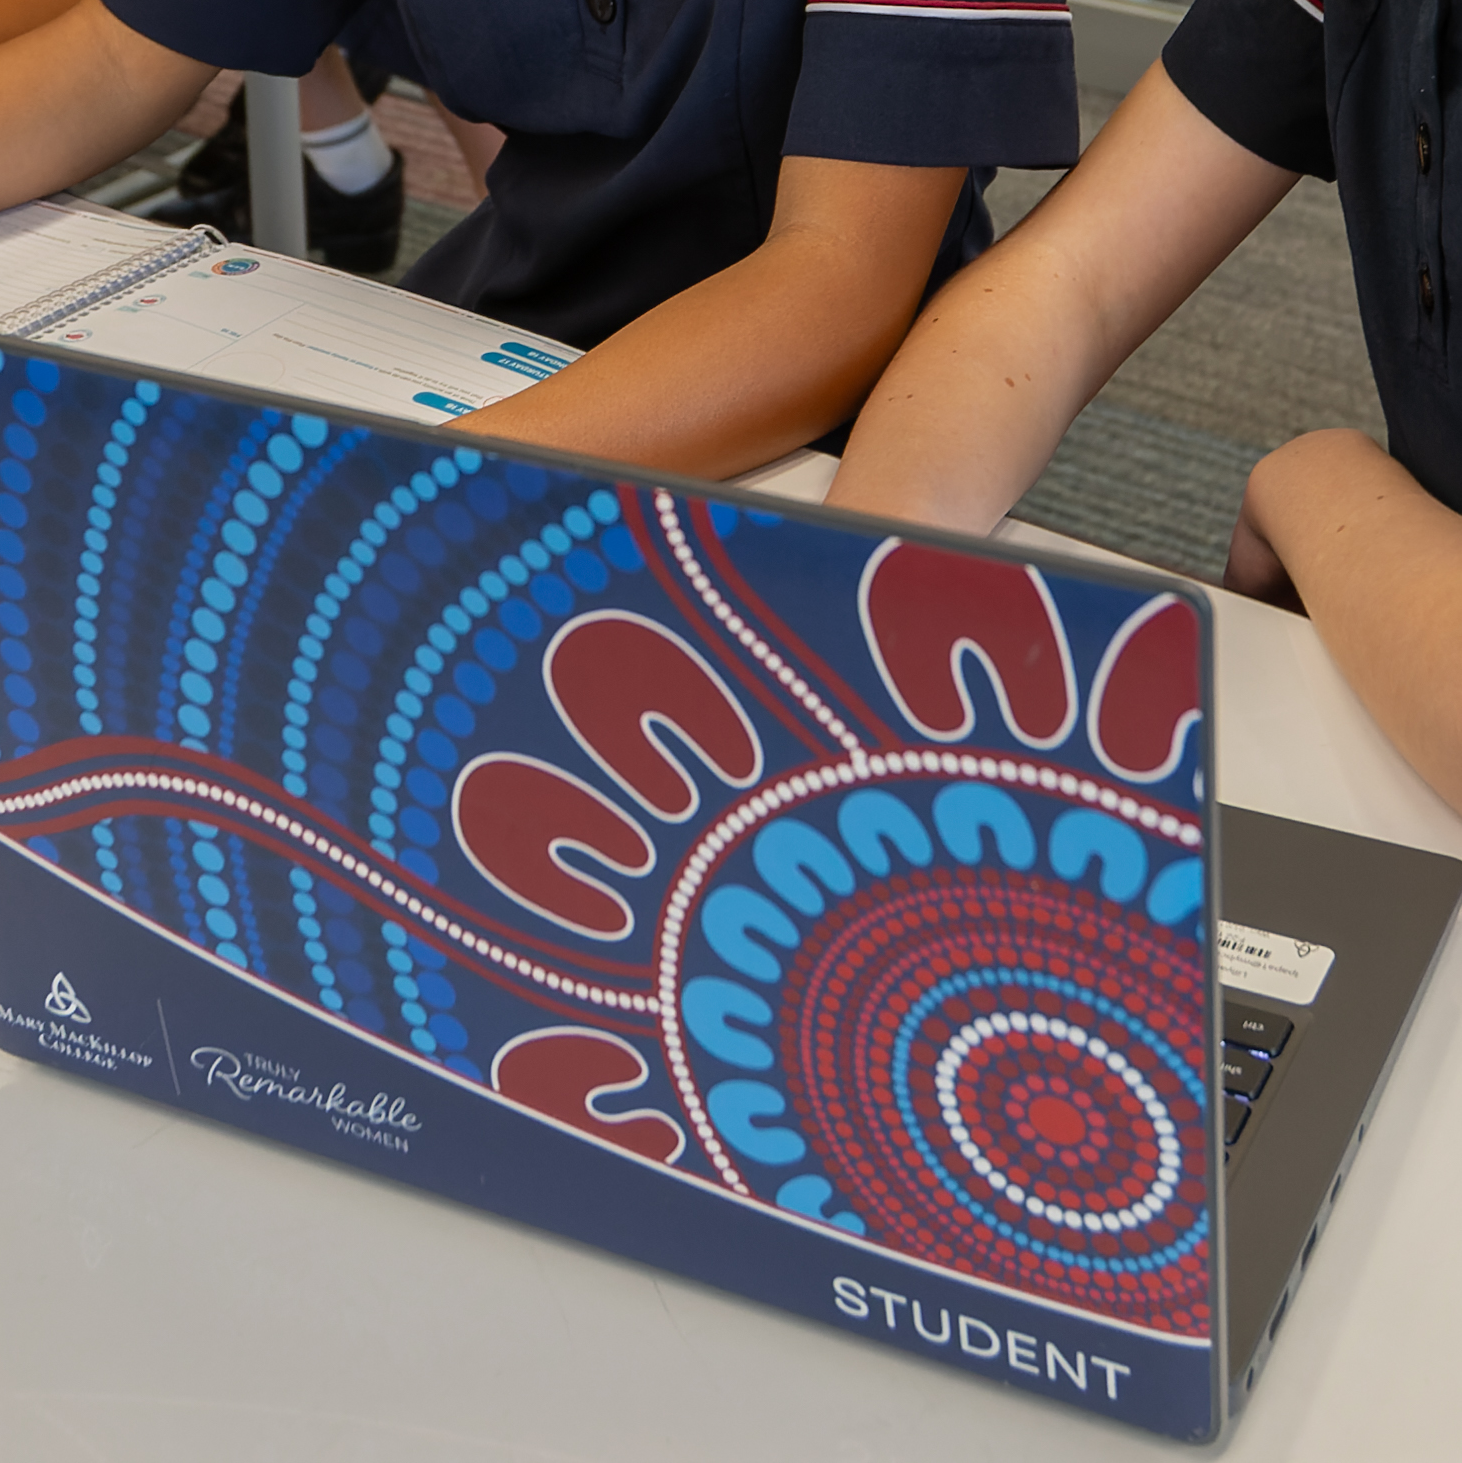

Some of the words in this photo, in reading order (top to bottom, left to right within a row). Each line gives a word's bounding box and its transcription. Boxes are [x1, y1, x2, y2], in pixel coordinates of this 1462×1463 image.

[509, 361, 550, 380] ATURDAY
[243, 1051, 301, 1082] TRULY
[190, 1046, 423, 1132] Remarkable
[331, 1115, 410, 1154] WOMEN
[833, 1276, 1132, 1401] STUDENT
